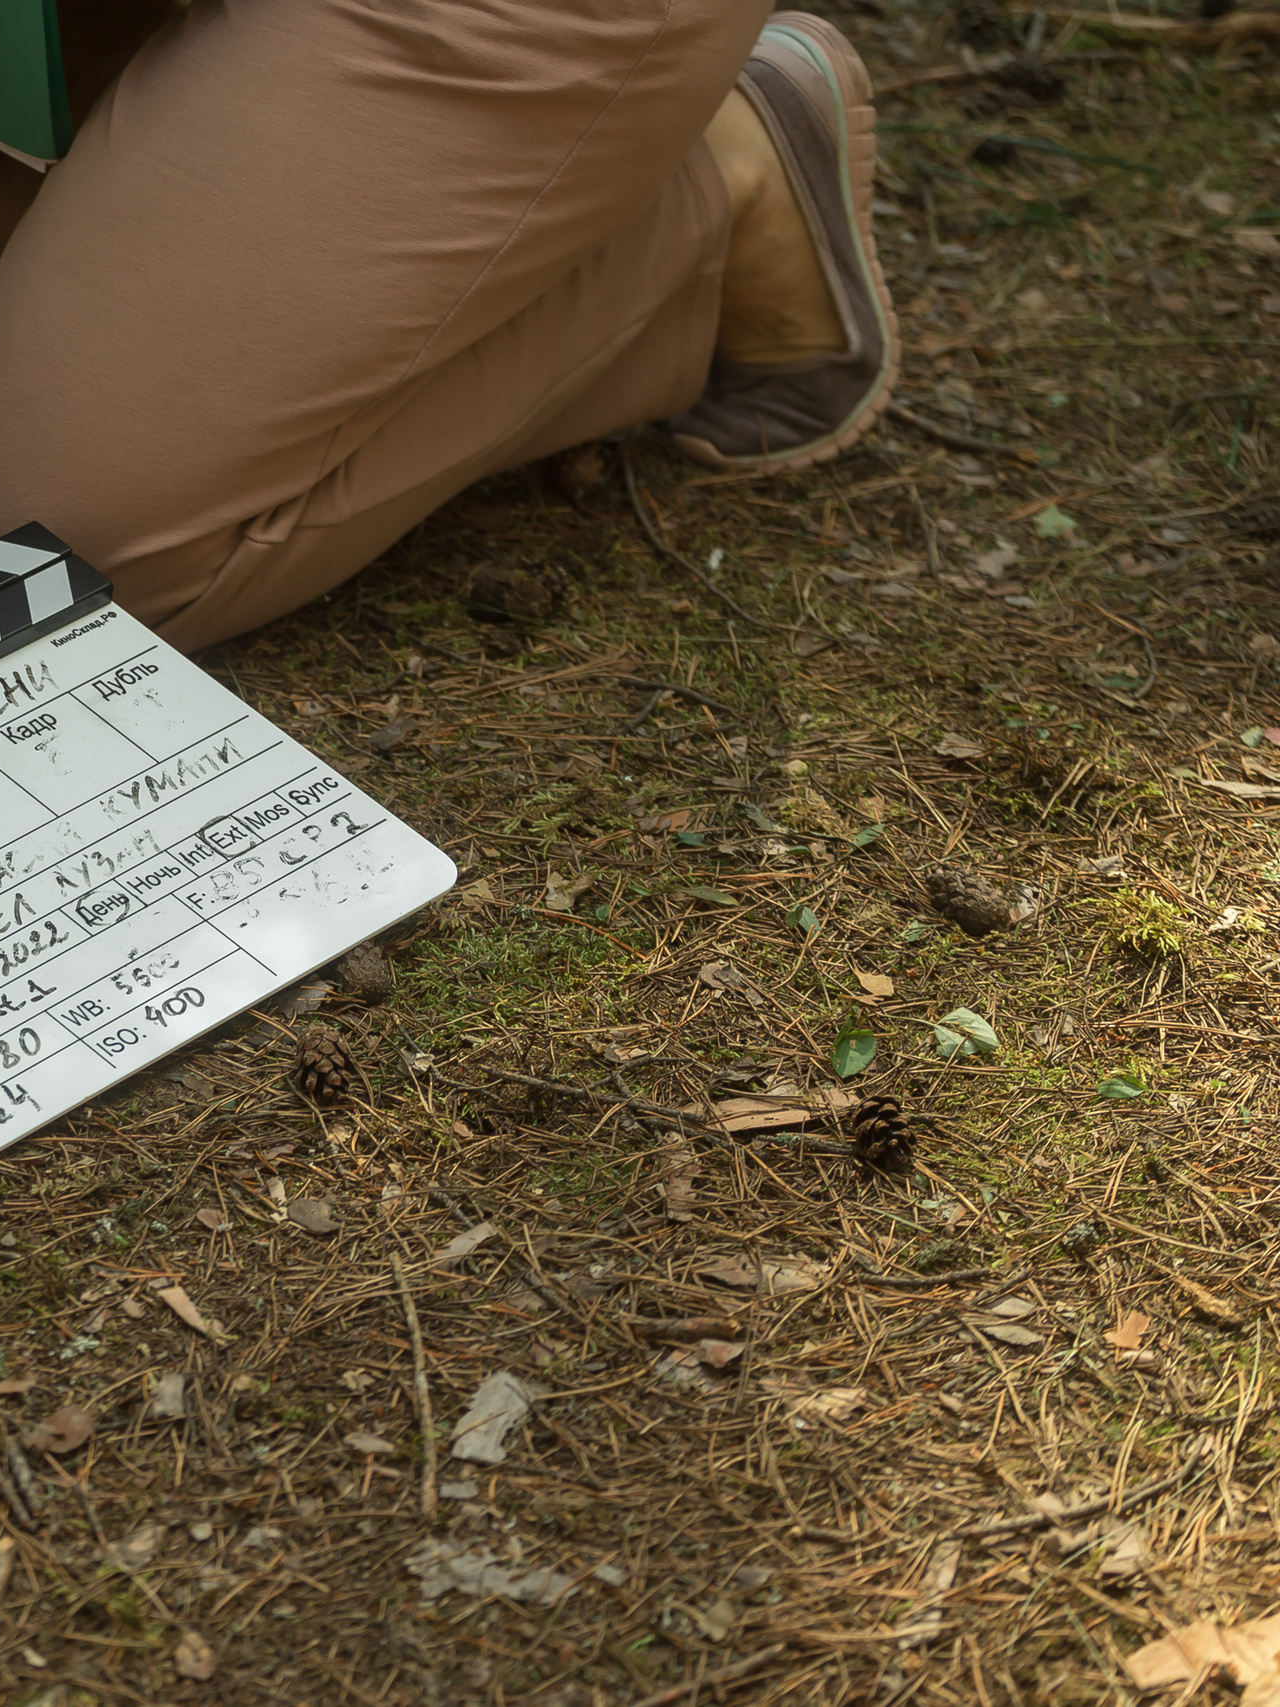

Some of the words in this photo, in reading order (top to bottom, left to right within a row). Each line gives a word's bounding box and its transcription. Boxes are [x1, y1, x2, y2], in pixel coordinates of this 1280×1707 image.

[50, 611, 117, 648] КиноСклад.РФ
[91, 664, 160, 701] Дубль
[0, 713, 58, 745] Кадр
[288, 776, 339, 806] Sync
[244, 803, 290, 830] Mos
[208, 825, 248, 849] Ext
[178, 843, 212, 867] Int
[126, 865, 182, 894] Ночь
[76, 892, 129, 927] День
[186, 893, 215, 911] F:
[61, 998, 111, 1026] WB:
[145, 986, 206, 1028] 400
[96, 1027, 147, 1057] ISO:
